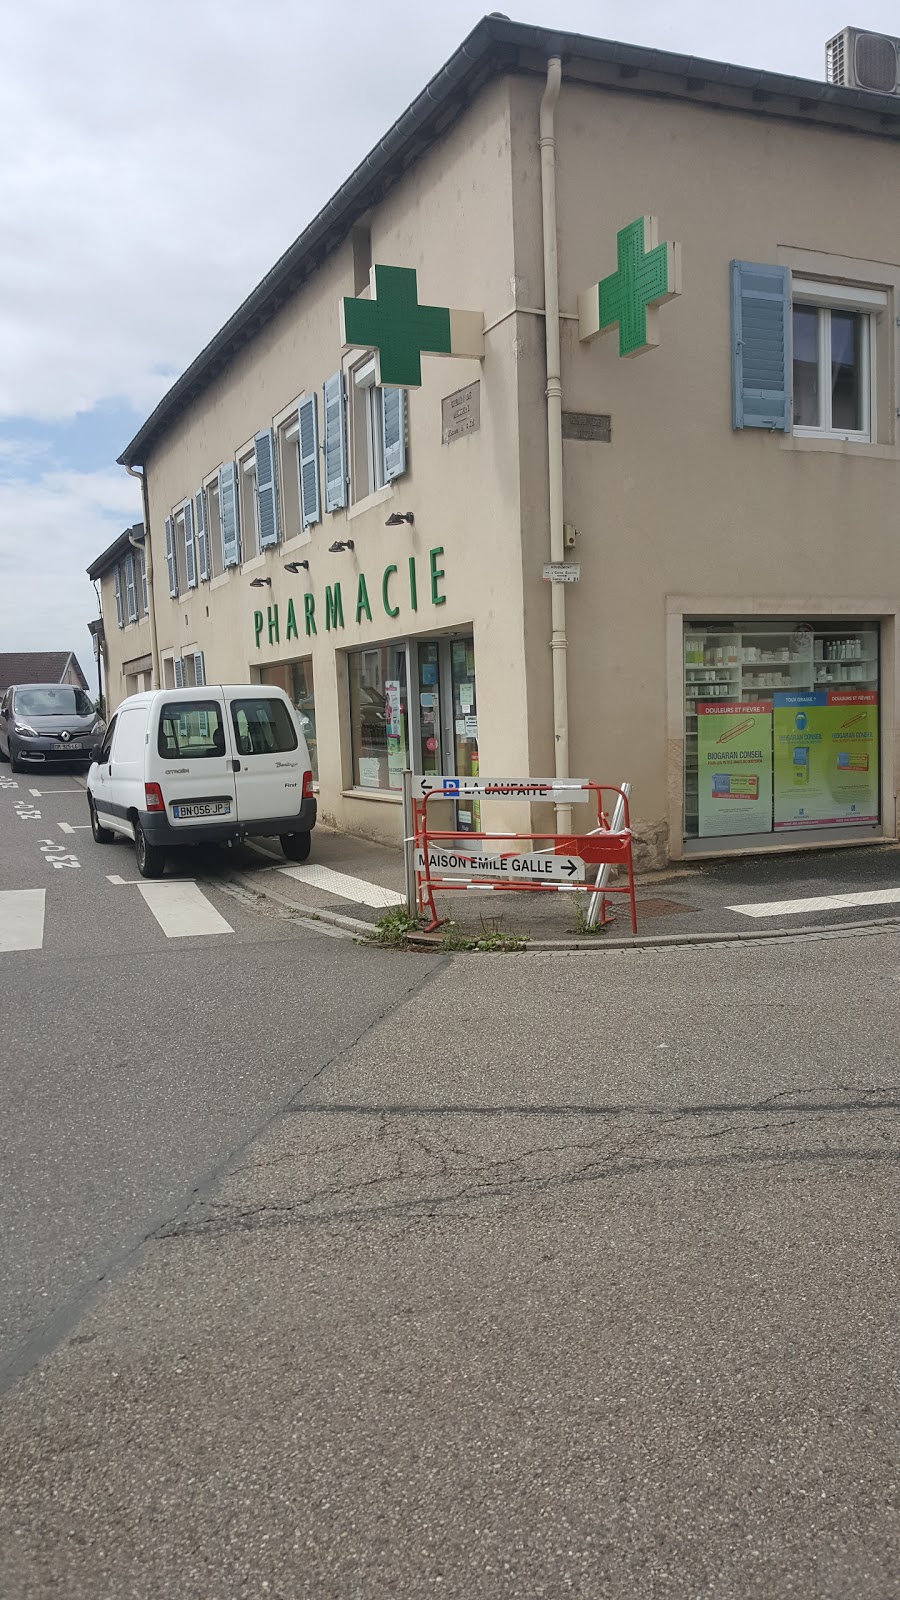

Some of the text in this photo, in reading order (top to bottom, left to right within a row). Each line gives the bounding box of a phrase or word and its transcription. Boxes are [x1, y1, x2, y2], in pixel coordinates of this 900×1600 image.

[253, 546, 447, 648] PHARMACIE
[707, 750, 763, 760] BIOGARAN CONSEIL
[464, 782, 481, 795] LA
[180, 803, 223, 816] BN-056-JP
[418, 854, 553, 873] MAISON EMILE GALLE
